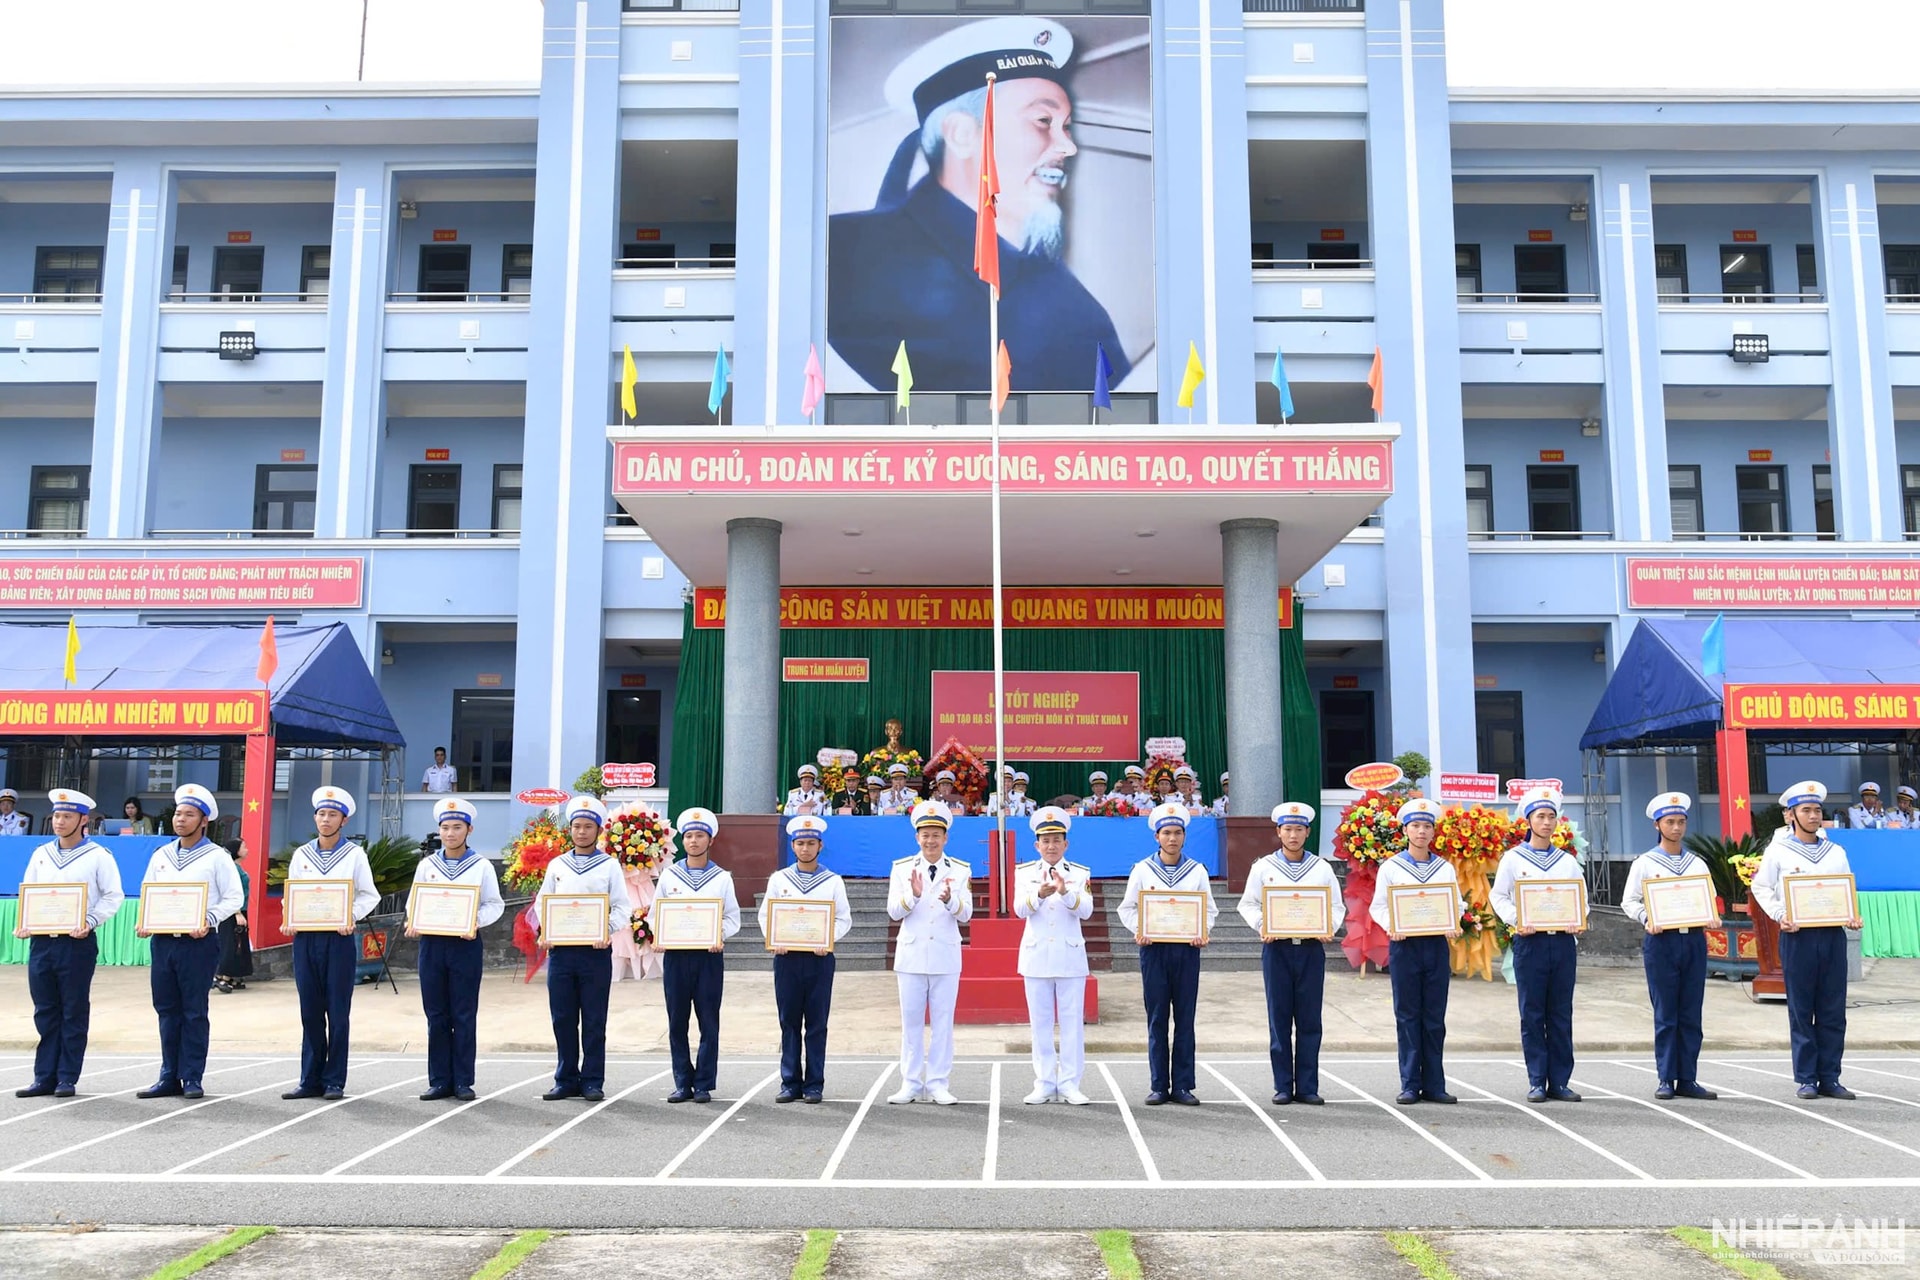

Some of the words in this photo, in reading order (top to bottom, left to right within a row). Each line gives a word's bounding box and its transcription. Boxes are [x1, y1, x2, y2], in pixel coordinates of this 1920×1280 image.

[626, 452, 682, 482] DÂN
[690, 449, 752, 485] CHỦ,
[760, 452, 833, 482] ĐOÀN
[842, 449, 895, 485] KẾT,
[903, 449, 938, 482] KỶ
[1054, 451, 1128, 482] SÁNG
[1136, 455, 1193, 487] TẠO,
[1201, 449, 1285, 483] QUYẾT
[1292, 447, 1380, 481] THẮNG
[14, 565, 33, 580] SỨC
[35, 565, 64, 580] CHIẾN
[66, 564, 85, 580] ĐẤU
[87, 565, 107, 580] CỦA
[110, 565, 128, 580] CÁC
[131, 564, 149, 580] CẤP
[152, 564, 165, 581] ỦY,
[168, 564, 179, 580] TỔ
[182, 565, 207, 580] CHỨC
[210, 564, 239, 581] ĐẢNG;
[241, 565, 265, 580] PHÁT
[267, 567, 286, 580] HUY
[288, 565, 319, 580] TRÁCH
[321, 565, 353, 582] NHIỆM
[1637, 565, 1660, 581] QUÁN
[1663, 566, 1685, 583] TRIỆT
[1687, 565, 1705, 580] SÂU
[1707, 564, 1724, 580] SẮC
[1726, 566, 1752, 583] MỆNH
[1754, 566, 1776, 583] LỆNH
[1778, 564, 1801, 580] HUẤN
[1803, 566, 1830, 583] LUYỆN
[1832, 565, 1857, 580] CHIẾN
[1860, 564, 1879, 582] ĐẤU;
[1881, 566, 1901, 580] BÁM
[1903, 566, 1919, 581] SÁT
[1, 584, 26, 600] ĐẢNG
[29, 586, 53, 602] VIÊN;
[56, 586, 74, 600] XÂY
[77, 587, 103, 603] DỰNG
[105, 584, 131, 600] ĐẢNG
[134, 586, 147, 602] BỘ
[150, 588, 179, 600] TRONG
[183, 587, 207, 602] SẠCH
[211, 585, 236, 600] VỮNG
[238, 587, 267, 602] MẠNH
[269, 585, 289, 599] TIÊU
[292, 582, 314, 599] BIỂU
[1693, 586, 1721, 603] NHIỆM
[1723, 588, 1735, 603] VỤ
[1737, 584, 1760, 601] HUẤN
[1762, 586, 1792, 603] LUYỆN;
[1794, 586, 1811, 601] XÂY
[1813, 588, 1836, 603] DỰNG
[1838, 588, 1866, 601] TRUNG
[1868, 586, 1886, 601] TÂM
[1889, 585, 1912, 601] CÁCH
[840, 591, 889, 620] SẢN
[895, 594, 942, 624] VIỆT
[1011, 598, 1088, 622] QUANG
[1095, 598, 1148, 620] VINH
[1156, 593, 1222, 620] MUÔN
[787, 664, 809, 676] TRUNG
[810, 662, 824, 676] TÂM
[826, 662, 843, 676] HUẤN
[845, 664, 865, 679] LUYỆN
[1005, 687, 1029, 709] TỐT
[1033, 690, 1080, 711] NGHIỆP
[1741, 690, 1783, 720] CHỦ
[1788, 691, 1849, 723] ĐỘNG,
[1854, 692, 1907, 720] SÁNG
[54, 699, 108, 728] NHẬN
[114, 699, 177, 728] NHIỆM
[182, 702, 209, 728] VỤ
[215, 698, 254, 725] MỚI
[957, 712, 972, 726] TẠO
[1015, 713, 1044, 725] CHUYÊN
[1046, 713, 1062, 725] MÔN
[1076, 713, 1099, 726] THUẬT
